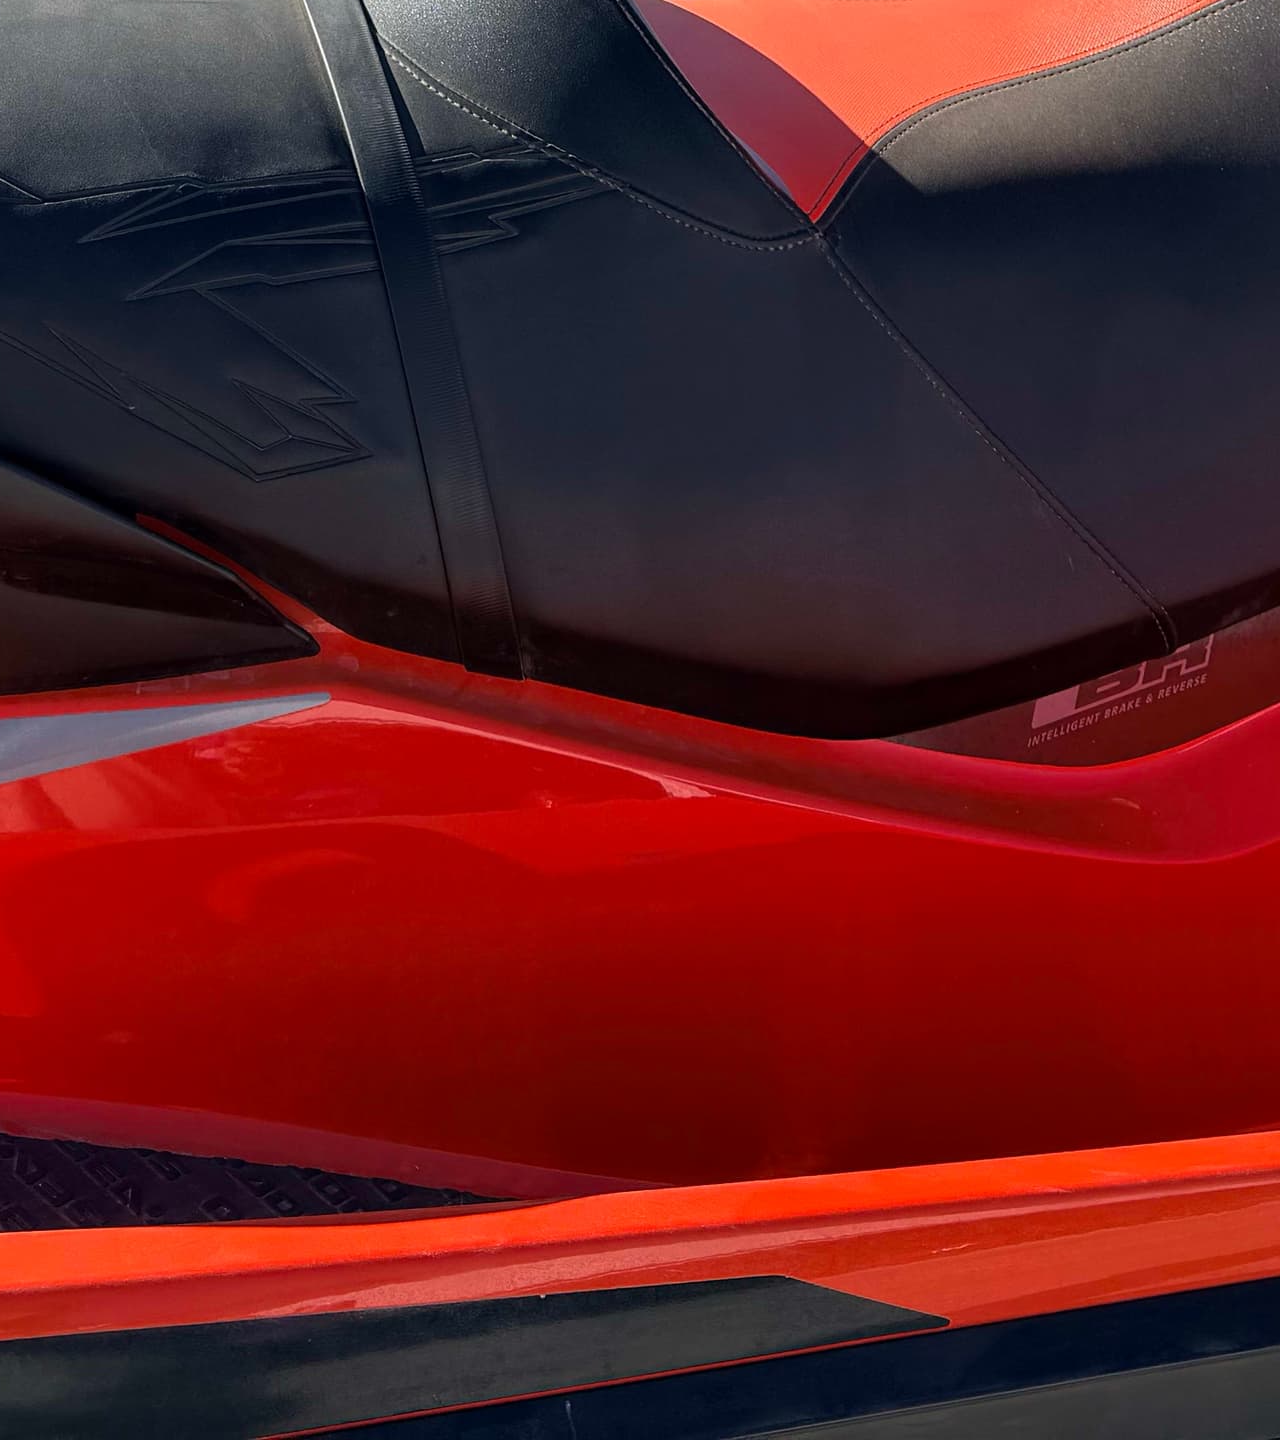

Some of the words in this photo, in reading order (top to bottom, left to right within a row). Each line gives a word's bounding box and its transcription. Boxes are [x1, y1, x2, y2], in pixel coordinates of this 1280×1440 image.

[1027, 713, 1100, 748] INTELLIGENT
[1104, 694, 1142, 720] BRAKE
[1145, 692, 1154, 704] &
[1157, 673, 1209, 700] REVERSE
